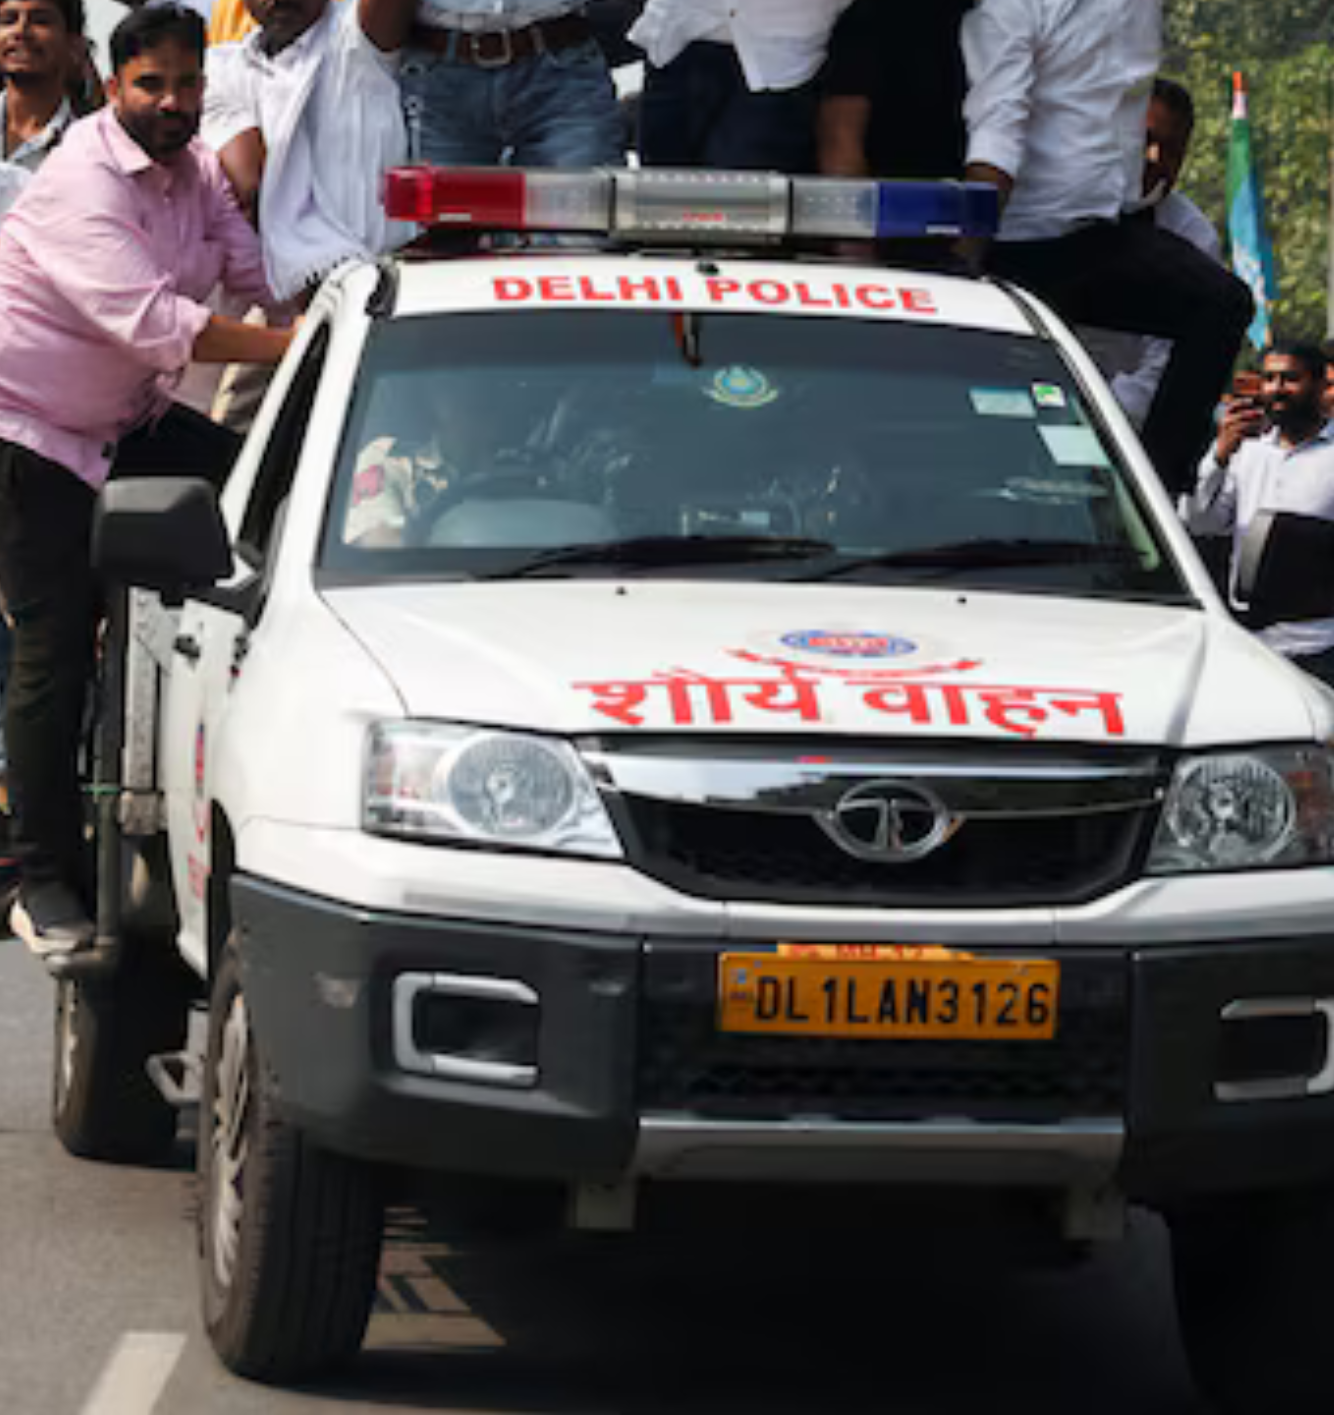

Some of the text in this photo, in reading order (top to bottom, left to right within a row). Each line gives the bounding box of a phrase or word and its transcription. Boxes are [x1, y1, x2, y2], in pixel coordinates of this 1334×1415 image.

[492, 274, 938, 315] DELHI POLICE
[571, 662, 1126, 740] शौर्य वाहन
